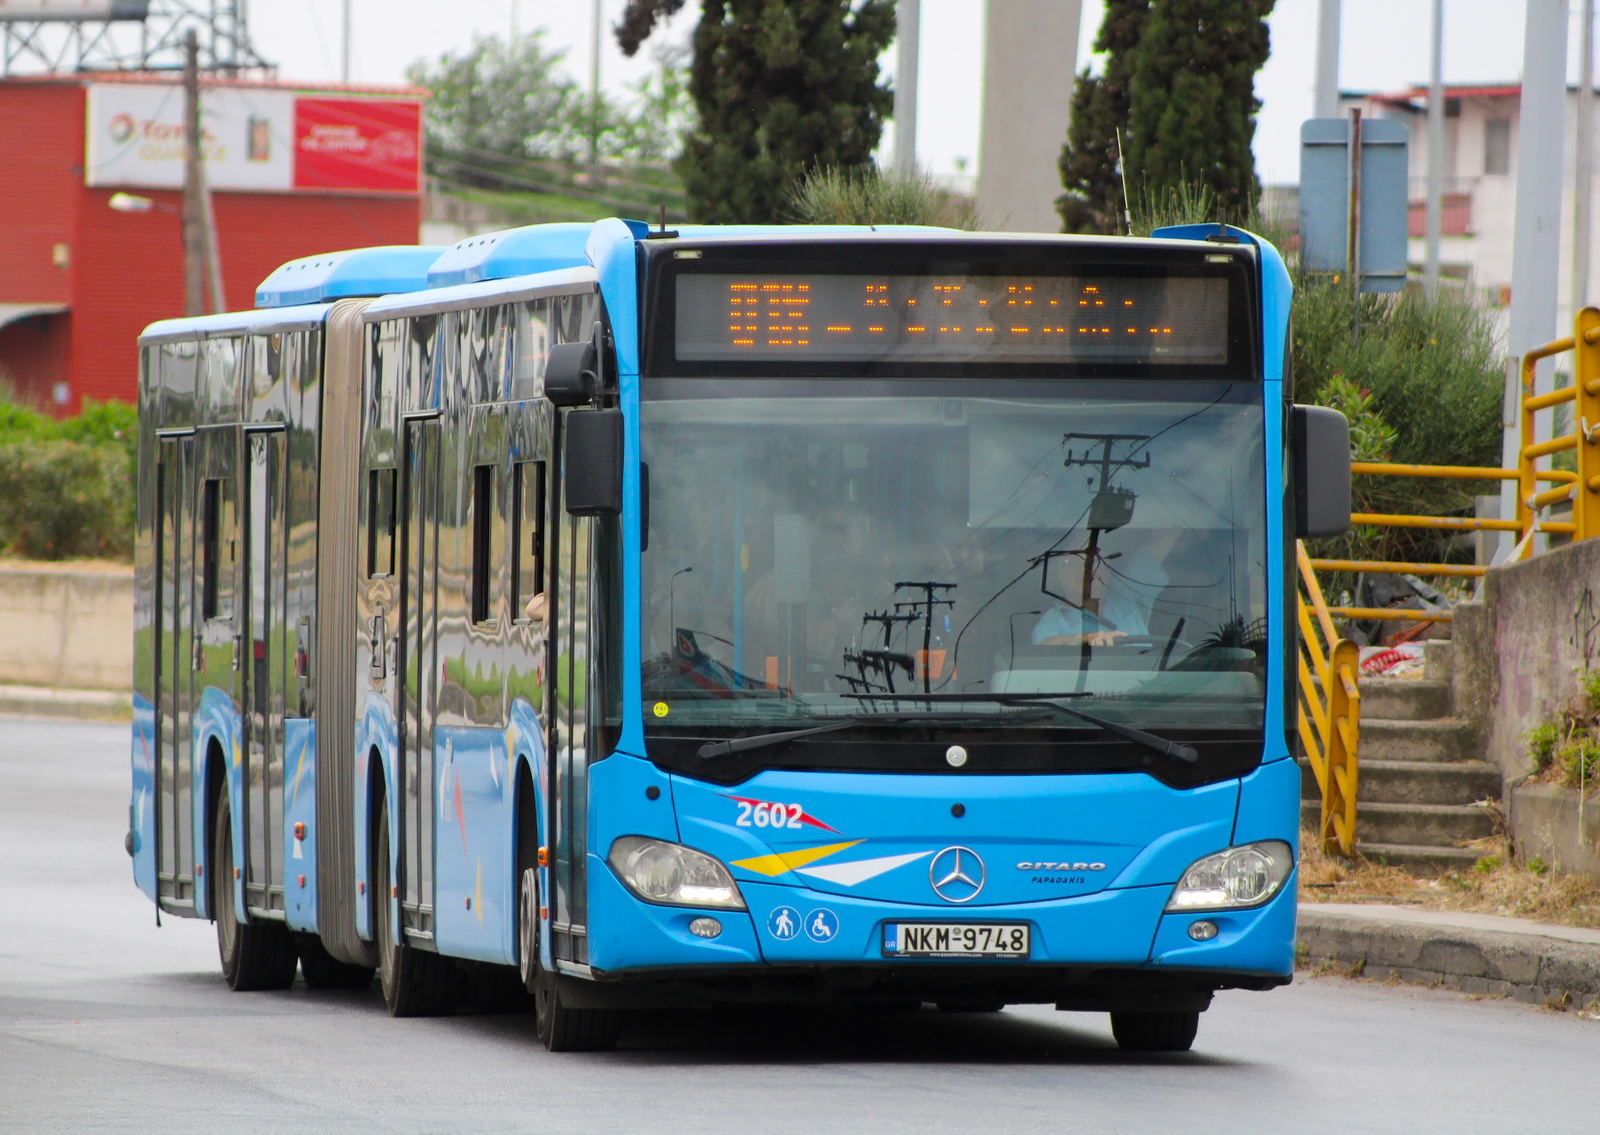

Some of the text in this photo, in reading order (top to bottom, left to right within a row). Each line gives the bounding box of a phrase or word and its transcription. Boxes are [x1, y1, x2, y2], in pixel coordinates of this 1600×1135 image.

[735, 801, 803, 829] 2602
[1016, 861, 1107, 871] CITARO
[1031, 876, 1086, 884] PAPADAKIS
[904, 927, 1024, 951] NKM-9748
